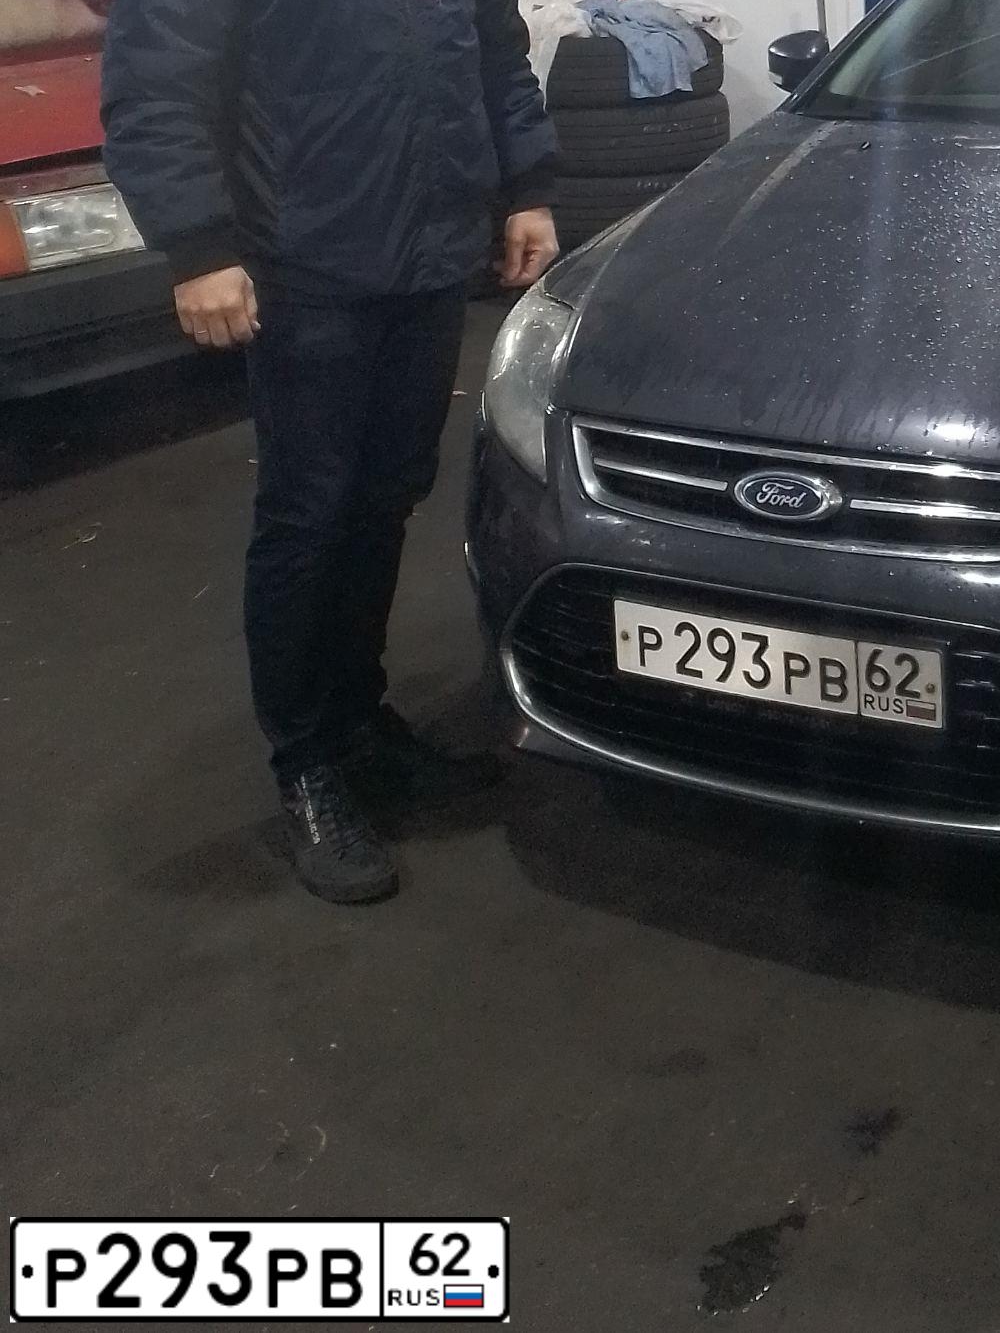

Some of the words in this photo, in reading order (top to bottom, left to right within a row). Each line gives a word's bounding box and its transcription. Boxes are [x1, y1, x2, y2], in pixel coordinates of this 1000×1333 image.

[756, 481, 807, 508] Ford
[865, 649, 921, 699] 62
[864, 693, 904, 715] RUS
